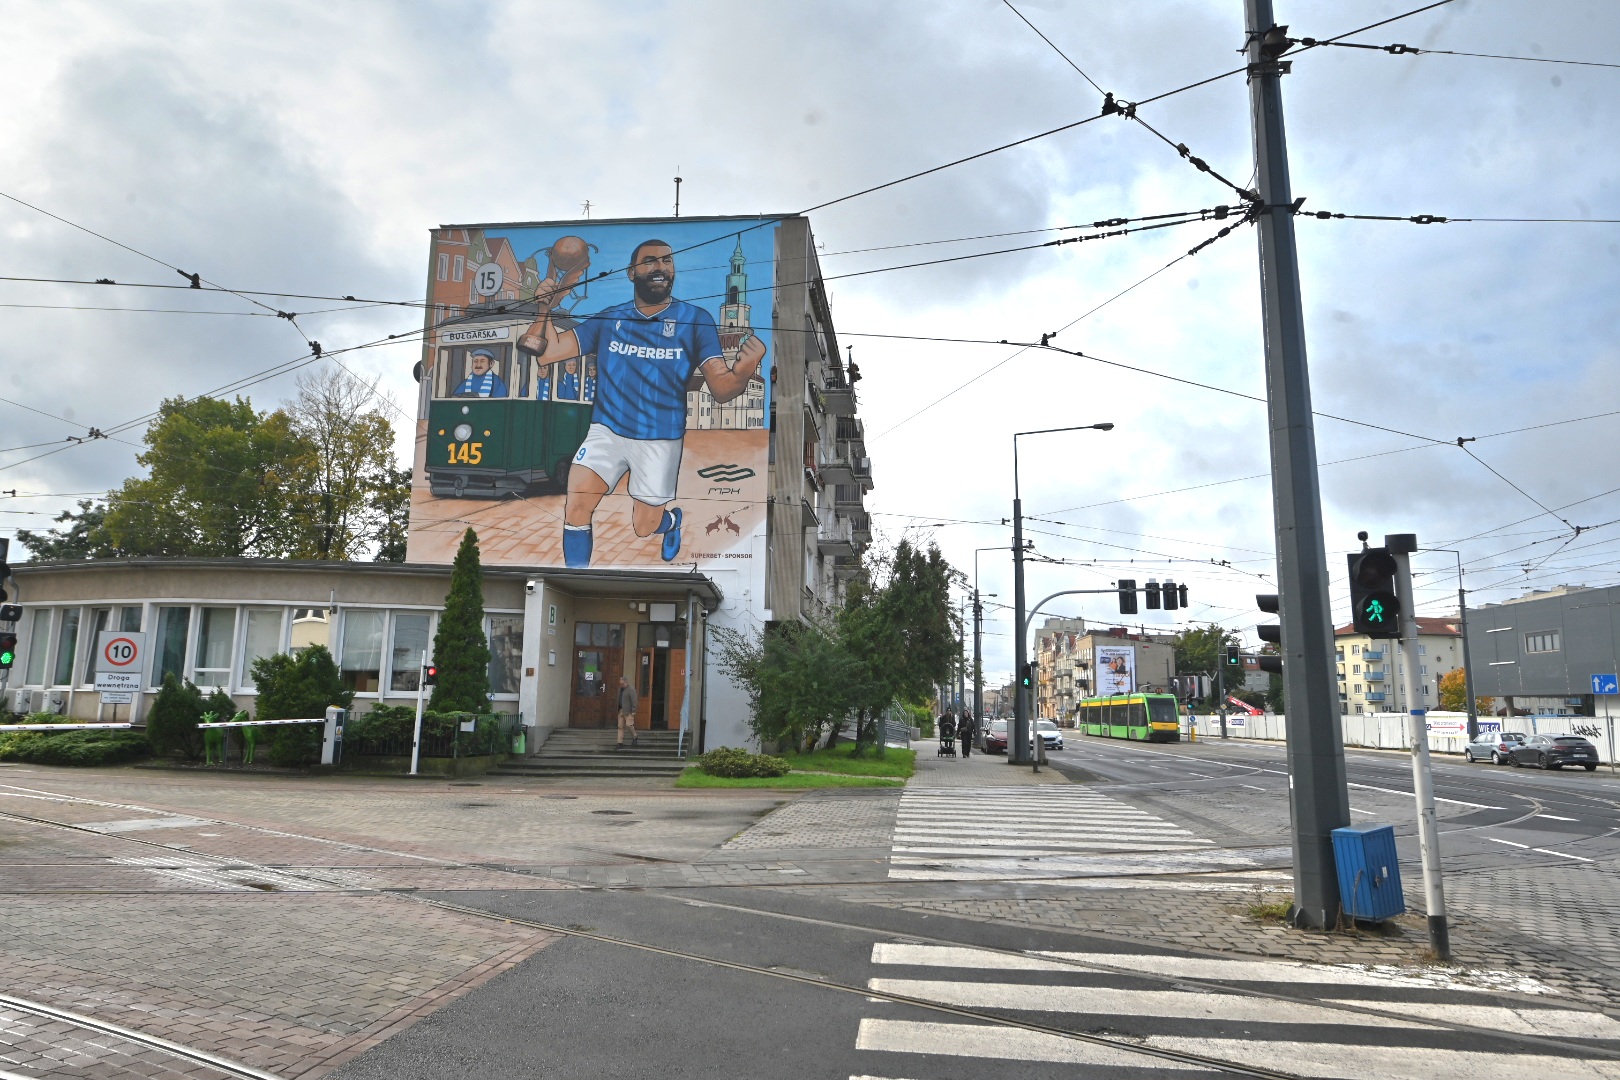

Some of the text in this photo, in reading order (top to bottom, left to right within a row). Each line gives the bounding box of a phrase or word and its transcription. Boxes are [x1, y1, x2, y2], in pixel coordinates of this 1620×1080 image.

[480, 271, 496, 290] 15
[449, 329, 498, 341] BUŁGARSKA
[608, 340, 683, 360] SUPERBET
[447, 442, 483, 465] 145
[576, 447, 587, 461] 9
[707, 487, 741, 496] MPK
[549, 606, 555, 624] B
[113, 644, 132, 659] 10
